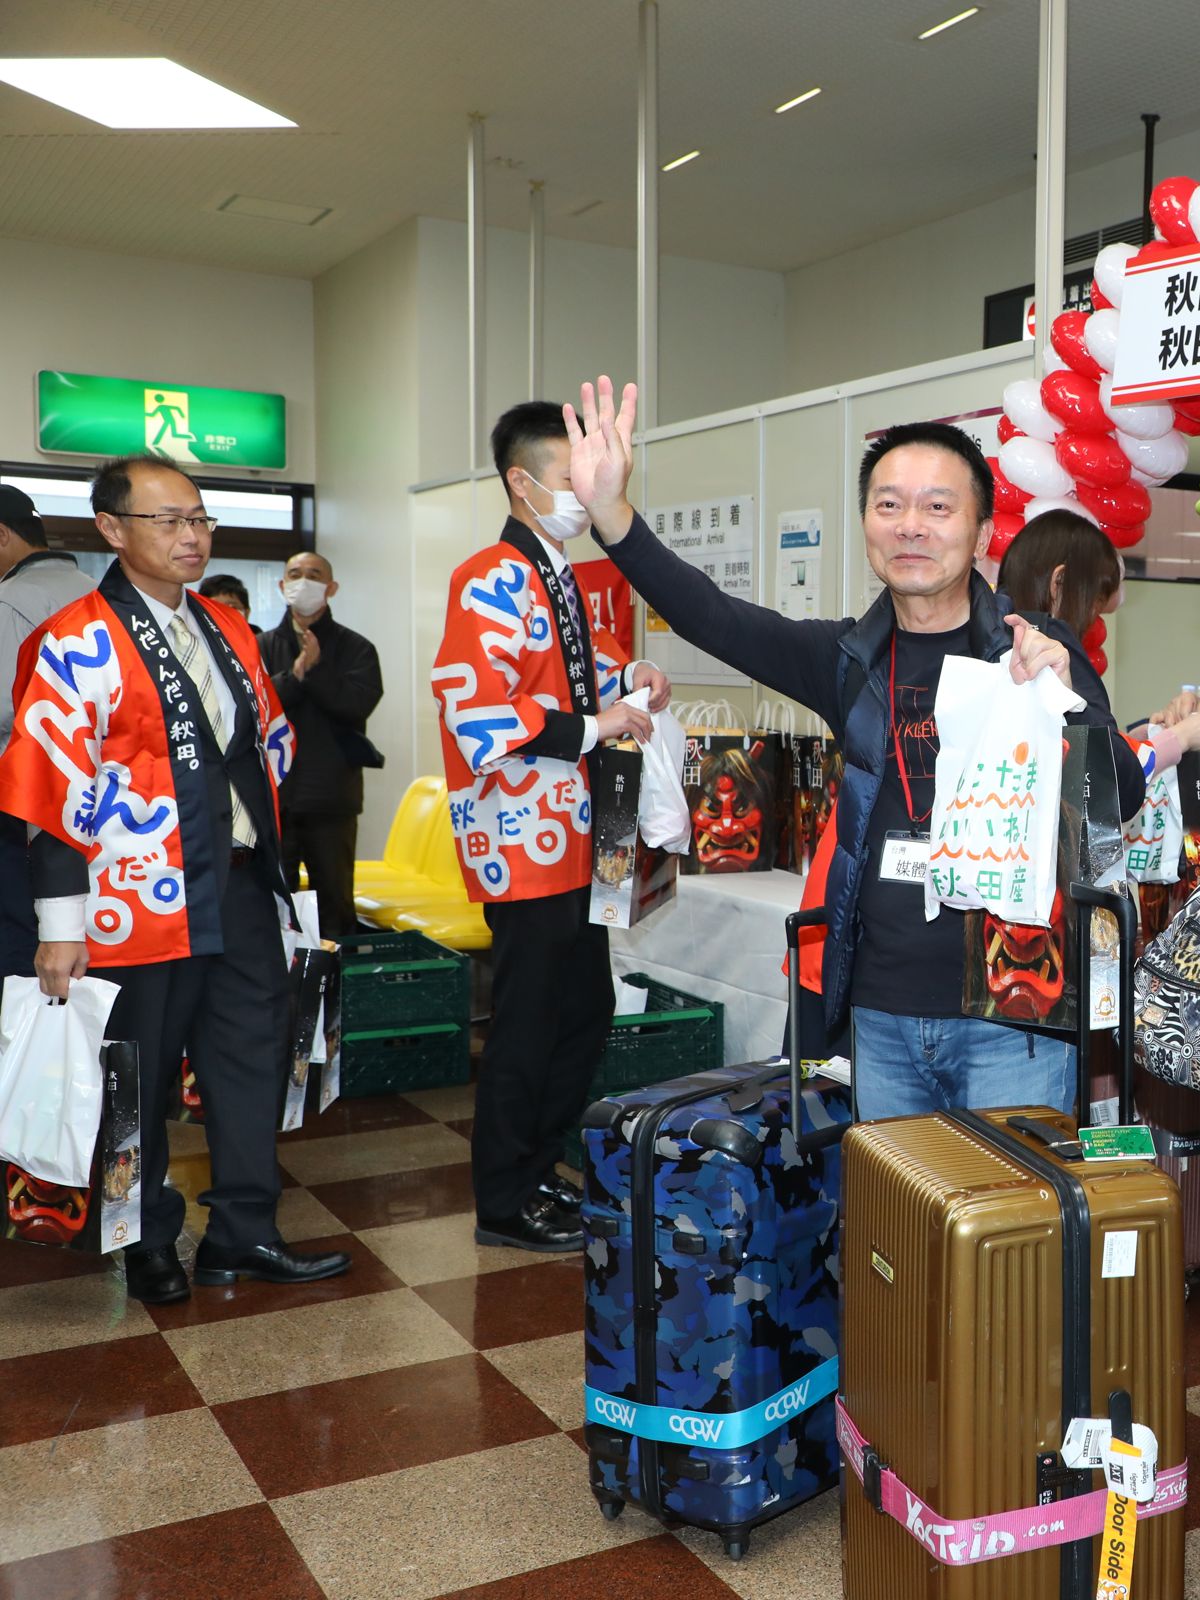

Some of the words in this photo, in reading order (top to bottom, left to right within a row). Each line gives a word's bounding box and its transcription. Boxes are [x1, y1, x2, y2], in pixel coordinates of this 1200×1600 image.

[656, 504, 740, 535] 国際線到着
[130, 614, 200, 771] んだ。んだ。秋田。
[615, 773, 625, 793] 秋田
[896, 860, 927, 878] 媒體
[930, 865, 1027, 903] 秋田産
[1021, 1518, 1066, 1540] .com
[1107, 1538, 1127, 1580] Side
